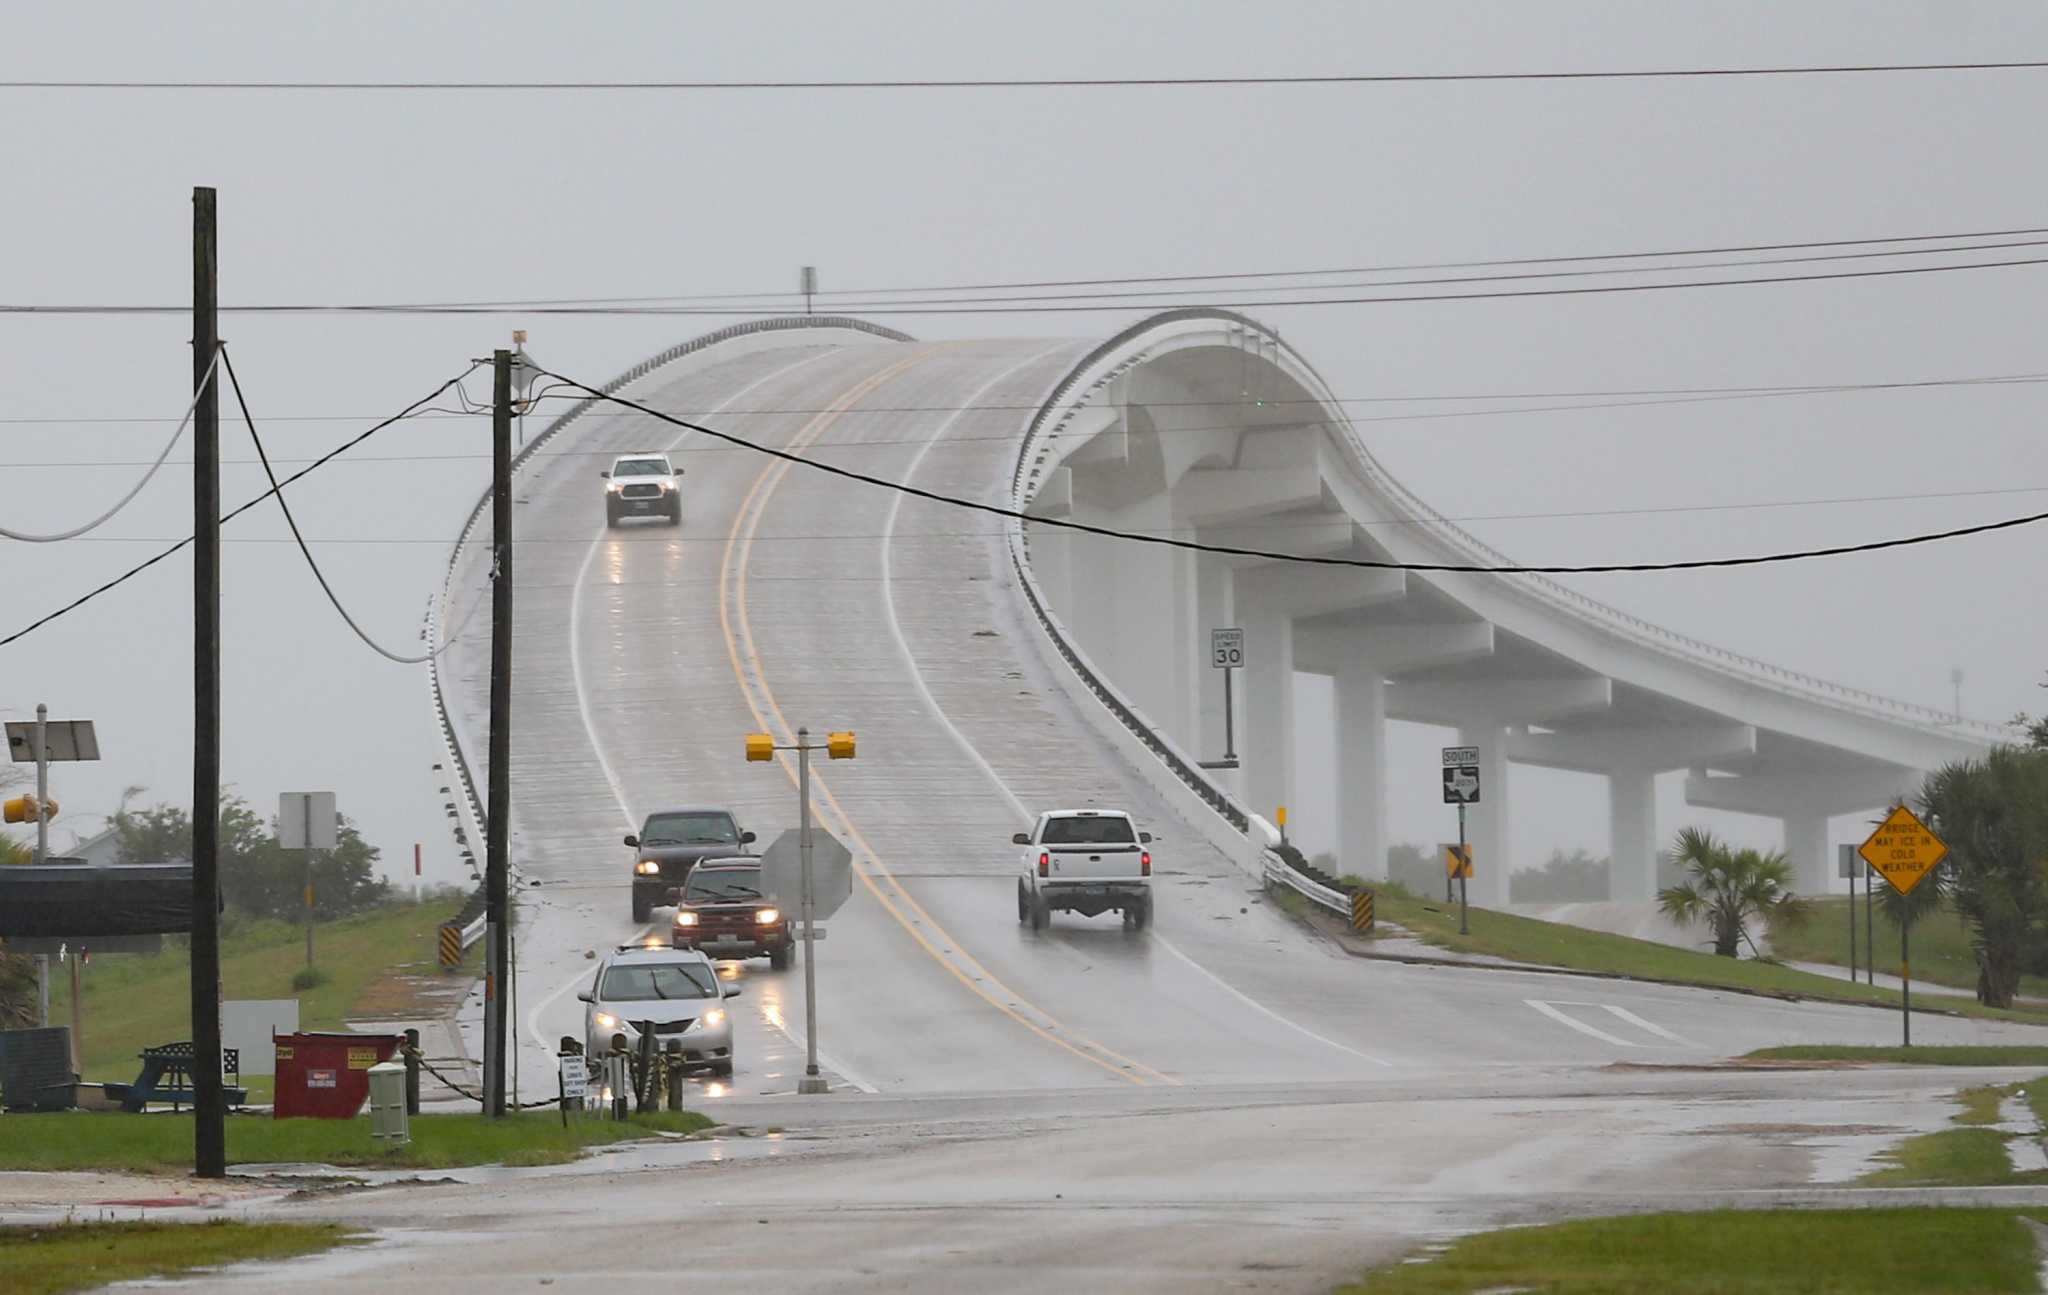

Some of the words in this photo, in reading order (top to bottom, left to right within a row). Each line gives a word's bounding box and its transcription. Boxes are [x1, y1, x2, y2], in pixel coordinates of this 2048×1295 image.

[1215, 632, 1241, 640] SPEED
[1216, 649, 1241, 663] 30
[1444, 751, 1477, 762] SOUTH
[1886, 823, 1920, 833] BRIDGE
[1875, 837, 1894, 847] MAY
[1901, 836, 1916, 846] ICE
[1921, 836, 1931, 846] IN
[1890, 849, 1916, 859] COLD
[1881, 863, 1925, 872] WEATHER
